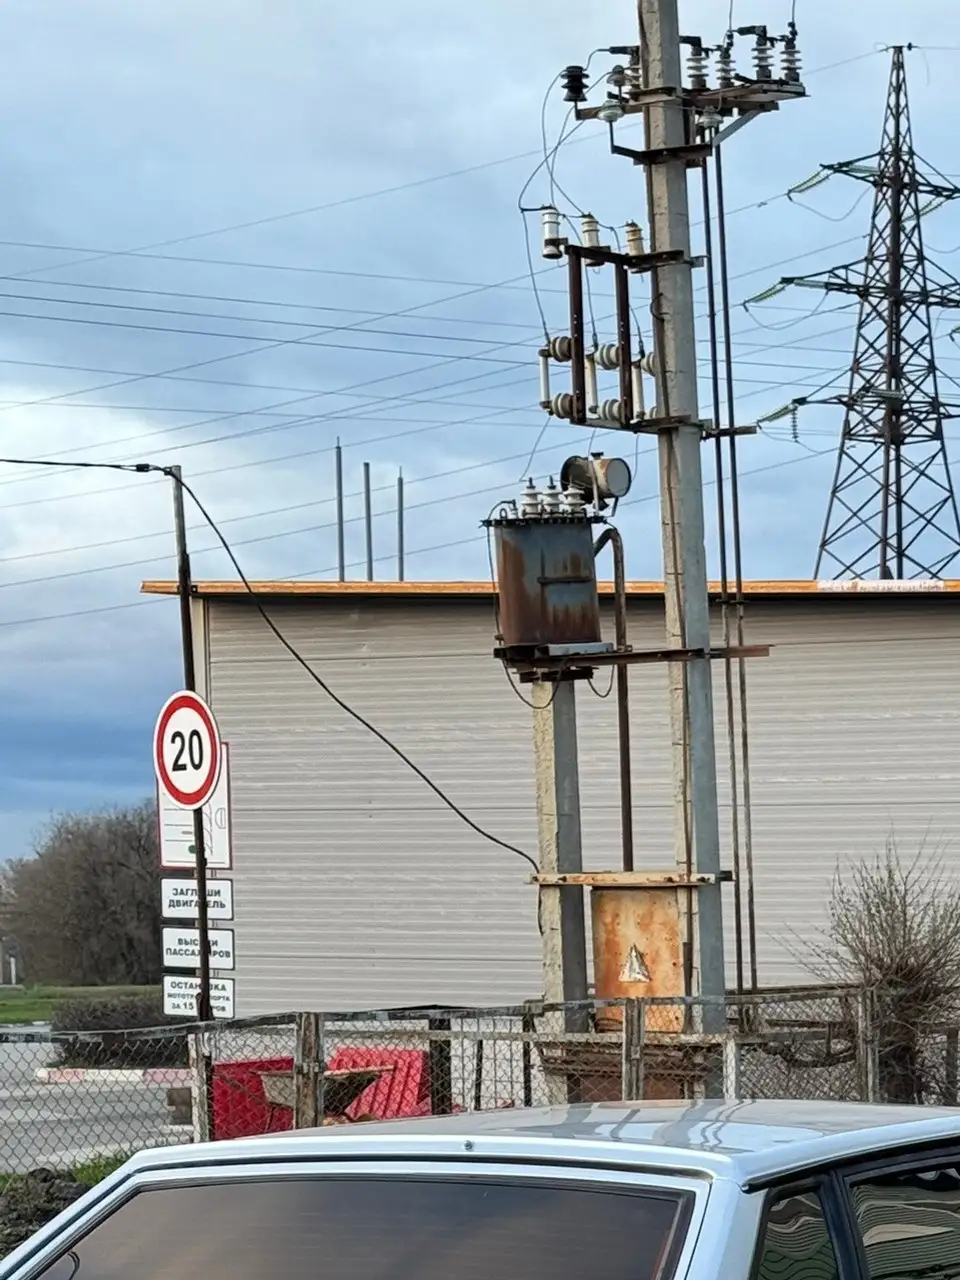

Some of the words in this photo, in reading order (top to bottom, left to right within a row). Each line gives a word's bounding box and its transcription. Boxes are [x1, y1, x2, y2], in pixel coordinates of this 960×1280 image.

[170, 729, 204, 771] 20
[172, 887, 221, 897] ЗАГЛШИ
[168, 899, 226, 909] ДВИГАЕЛЬ
[177, 938, 218, 947] ВЫСИ
[165, 948, 231, 958] ПАССАРОВ
[170, 981, 227, 992] ОСТАНВКА
[183, 1001, 195, 1011] 15
